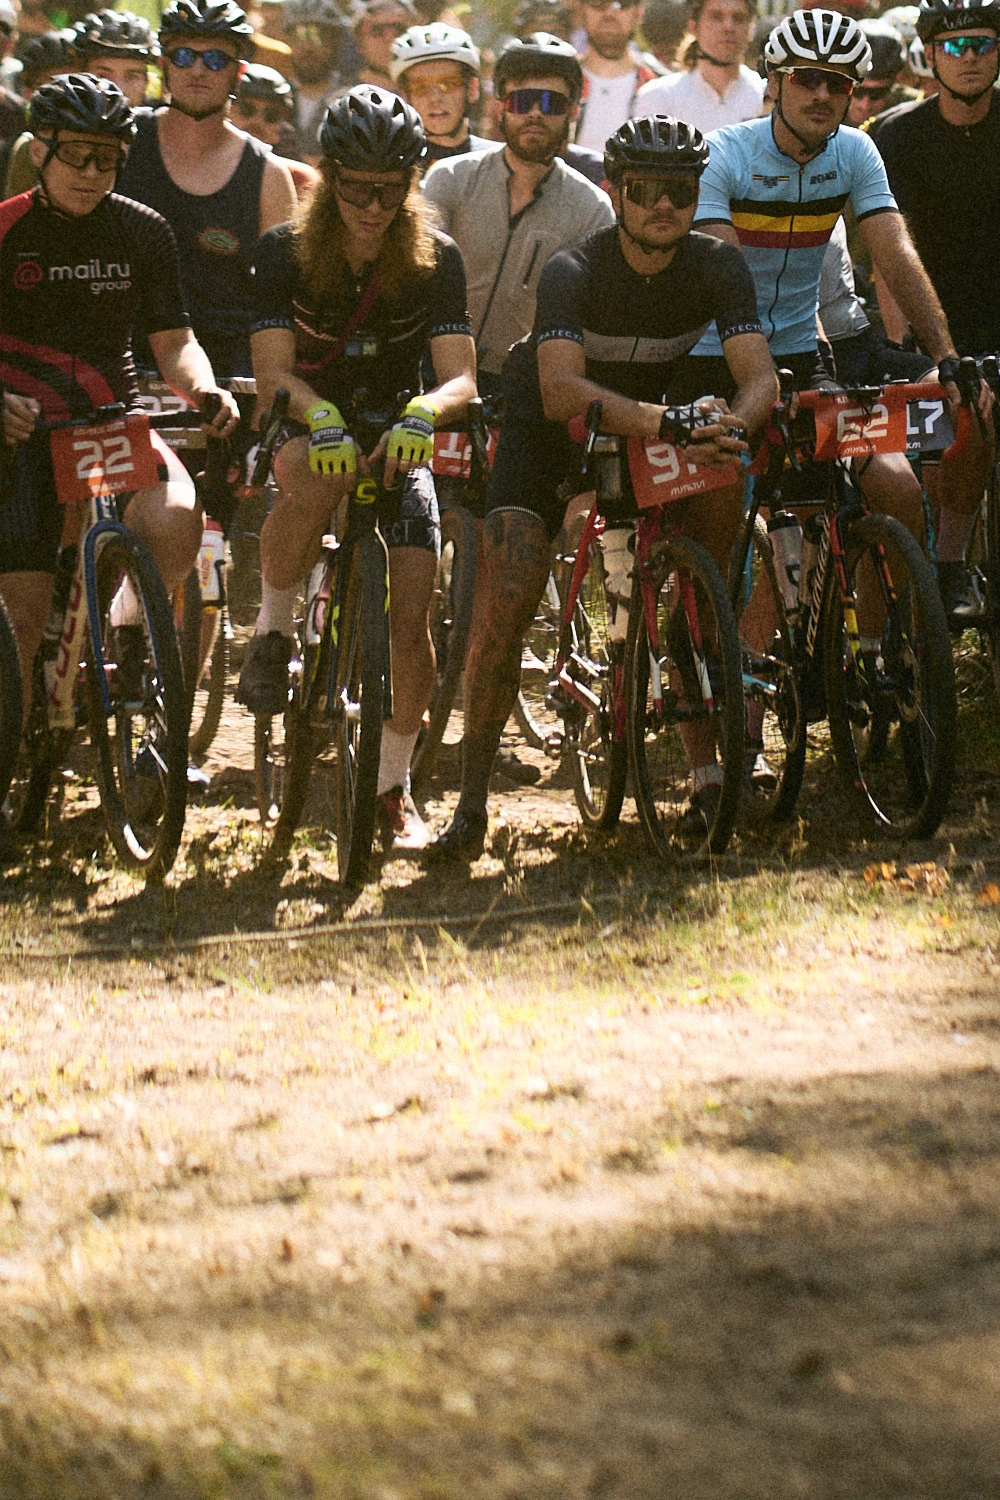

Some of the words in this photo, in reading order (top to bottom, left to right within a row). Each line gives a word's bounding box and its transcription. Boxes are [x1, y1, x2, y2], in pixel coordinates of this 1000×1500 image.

[48, 259, 131, 280] mail.ru
[90, 280, 132, 295] group
[72, 435, 135, 480] 22
[645, 443, 698, 485] 9
